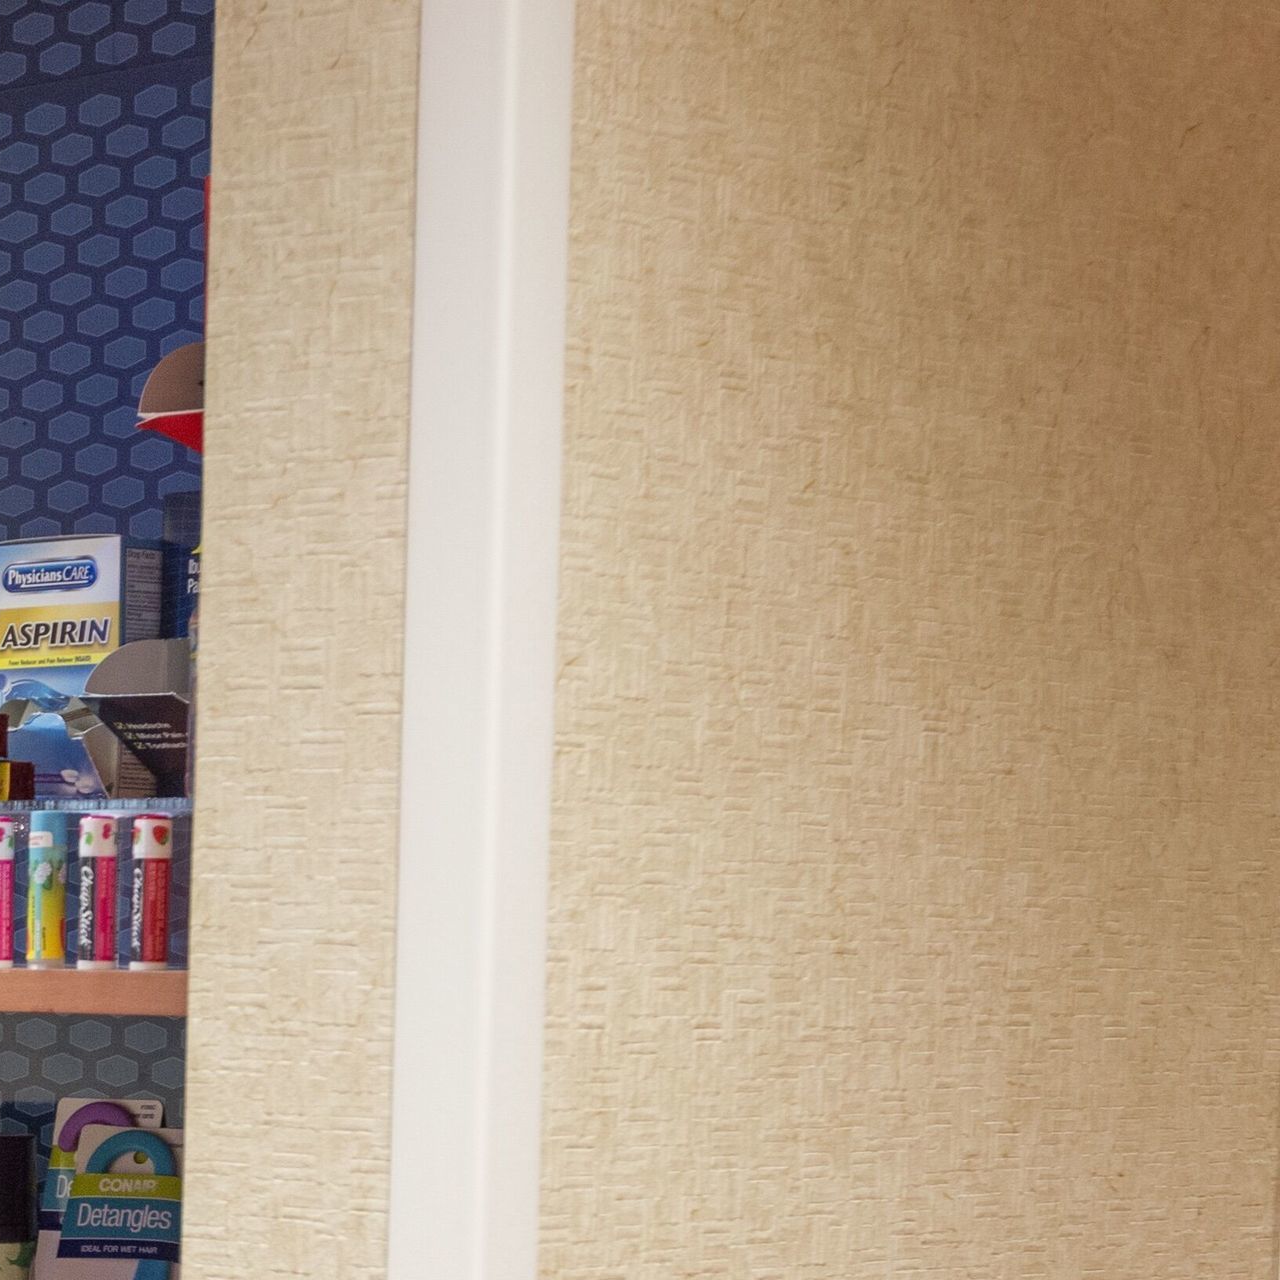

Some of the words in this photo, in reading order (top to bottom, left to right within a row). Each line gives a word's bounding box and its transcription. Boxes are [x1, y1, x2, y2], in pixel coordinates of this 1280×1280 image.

[0, 617, 110, 650] ASPIRIN
[78, 865, 94, 948] ChapStick
[132, 868, 143, 949] ChapStick
[98, 1177, 158, 1192] CONAIR
[76, 1203, 172, 1233] Detangles
